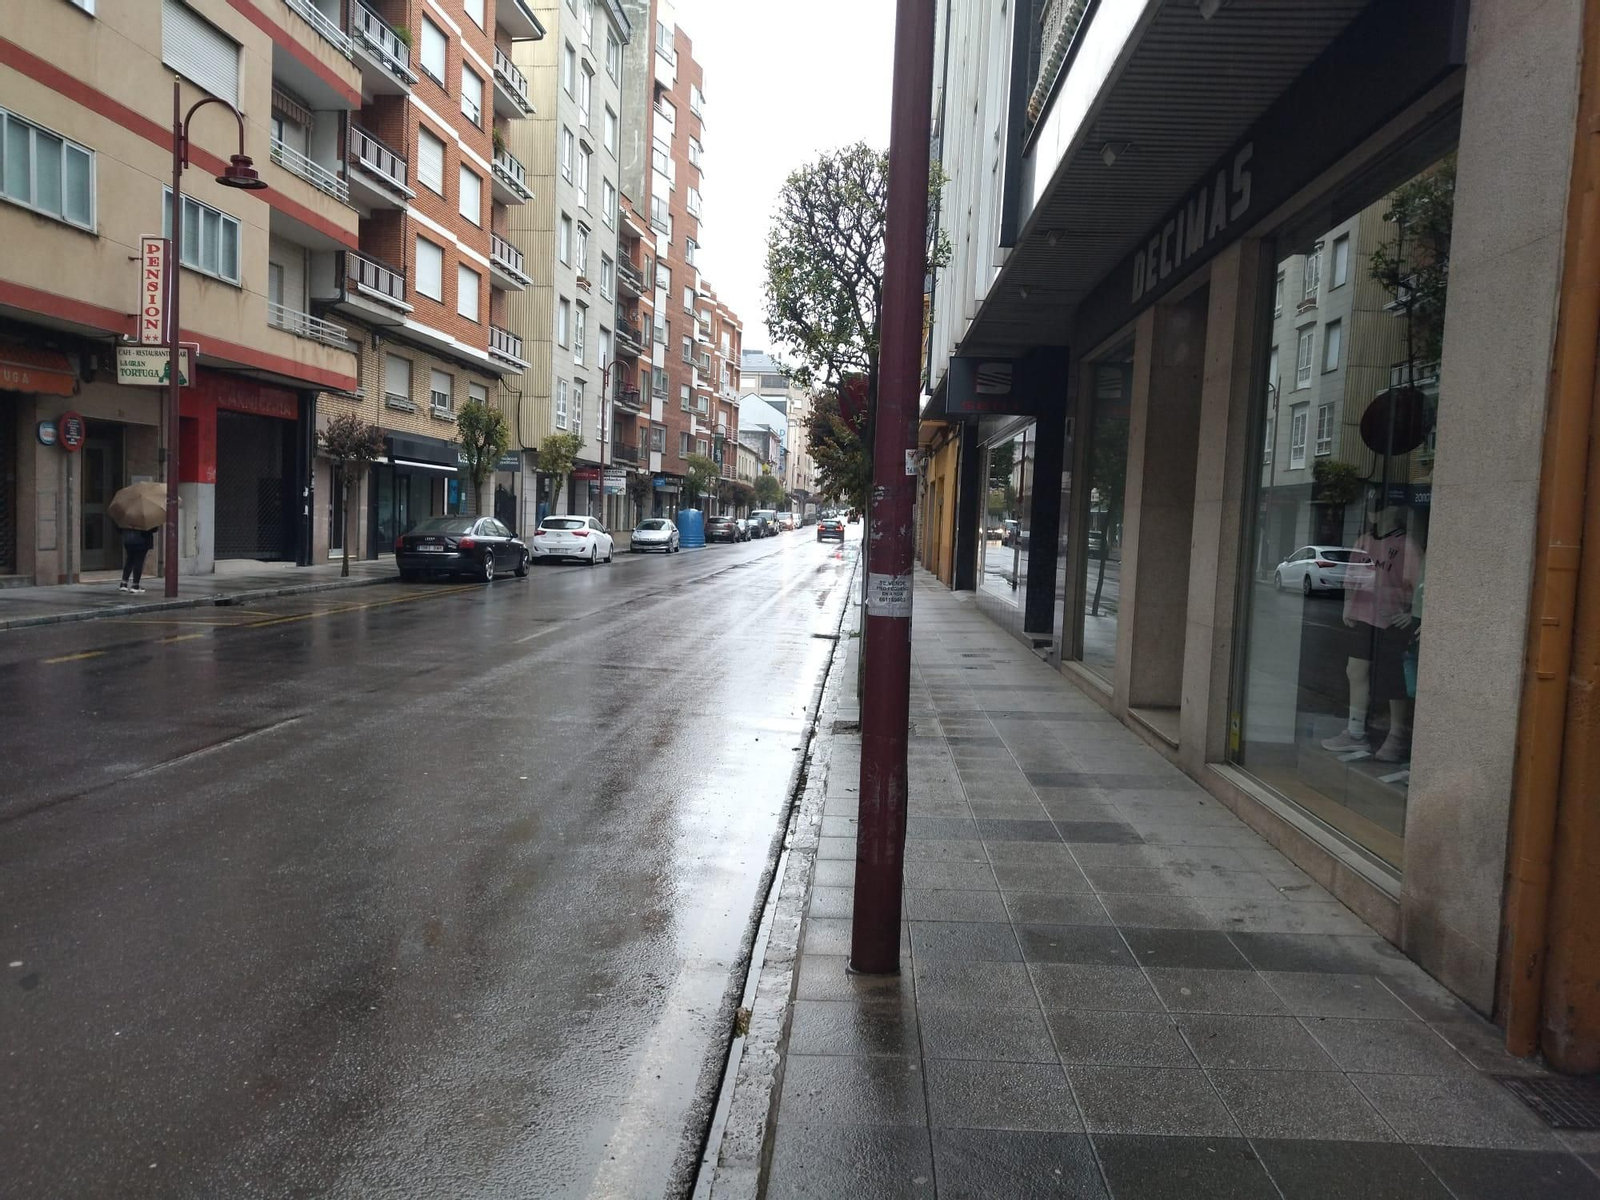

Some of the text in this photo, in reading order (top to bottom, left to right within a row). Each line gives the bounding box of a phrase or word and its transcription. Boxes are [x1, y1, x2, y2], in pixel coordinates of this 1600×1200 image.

[1132, 141, 1253, 304] DECIMAS
[144, 243, 161, 330] PENSION
[120, 368, 160, 378] TORTUGA
